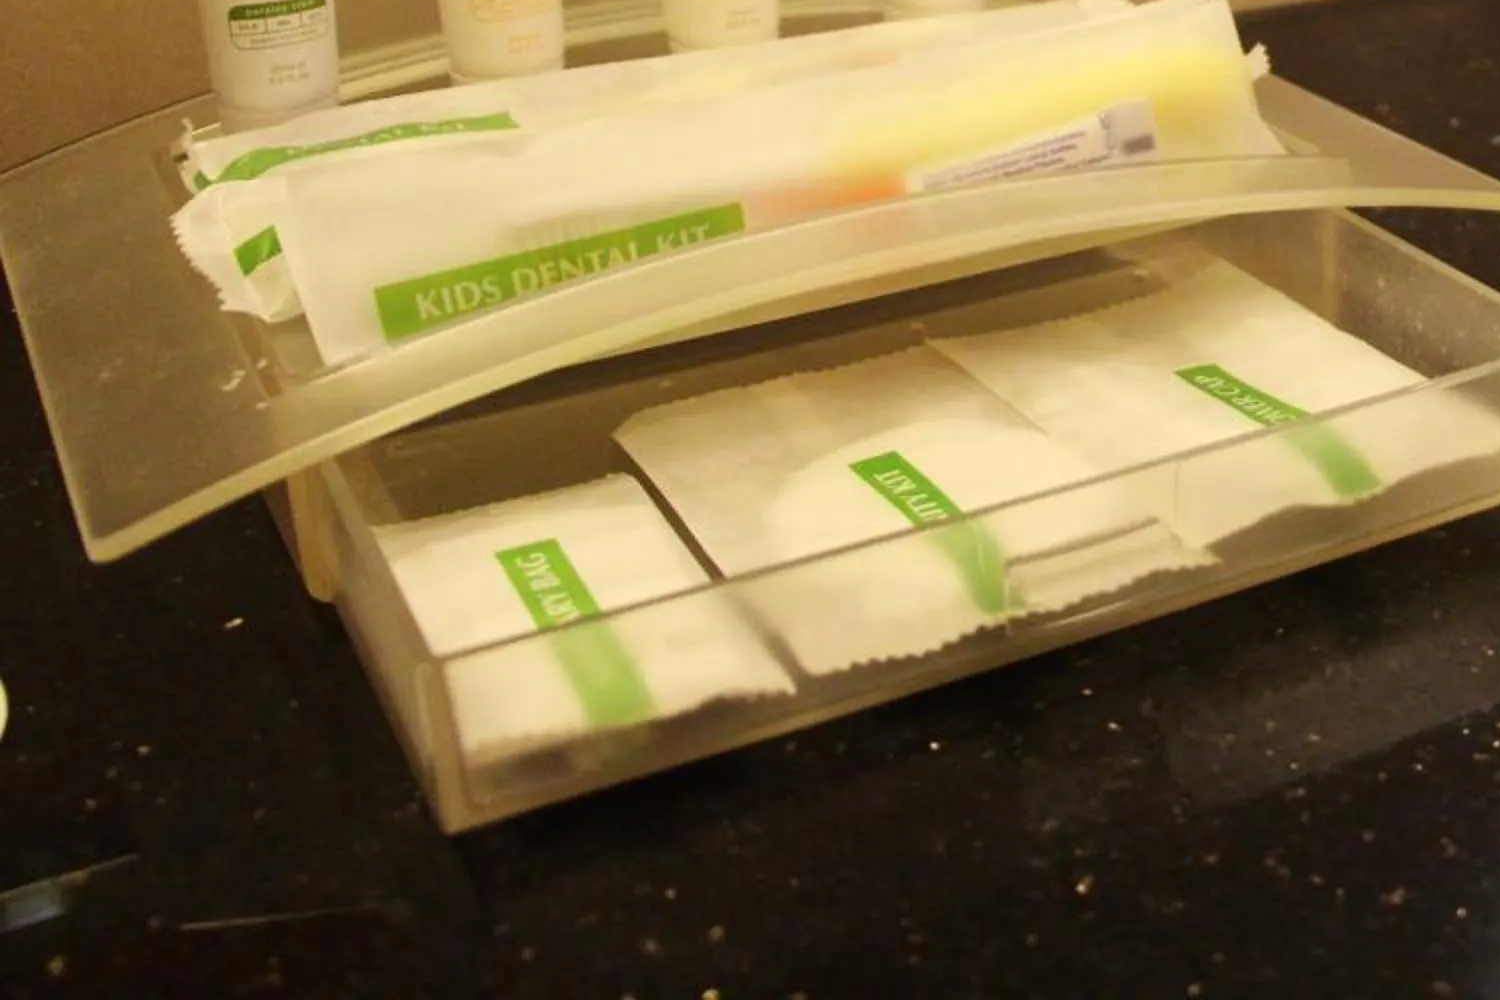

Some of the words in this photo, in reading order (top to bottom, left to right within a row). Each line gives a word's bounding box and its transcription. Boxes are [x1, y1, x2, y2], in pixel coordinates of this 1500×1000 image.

[414, 272, 502, 320] KIDS
[511, 240, 641, 298] DENTAL
[655, 224, 711, 258] KIT
[872, 468, 918, 496] KIT
[514, 551, 562, 592] BAG
